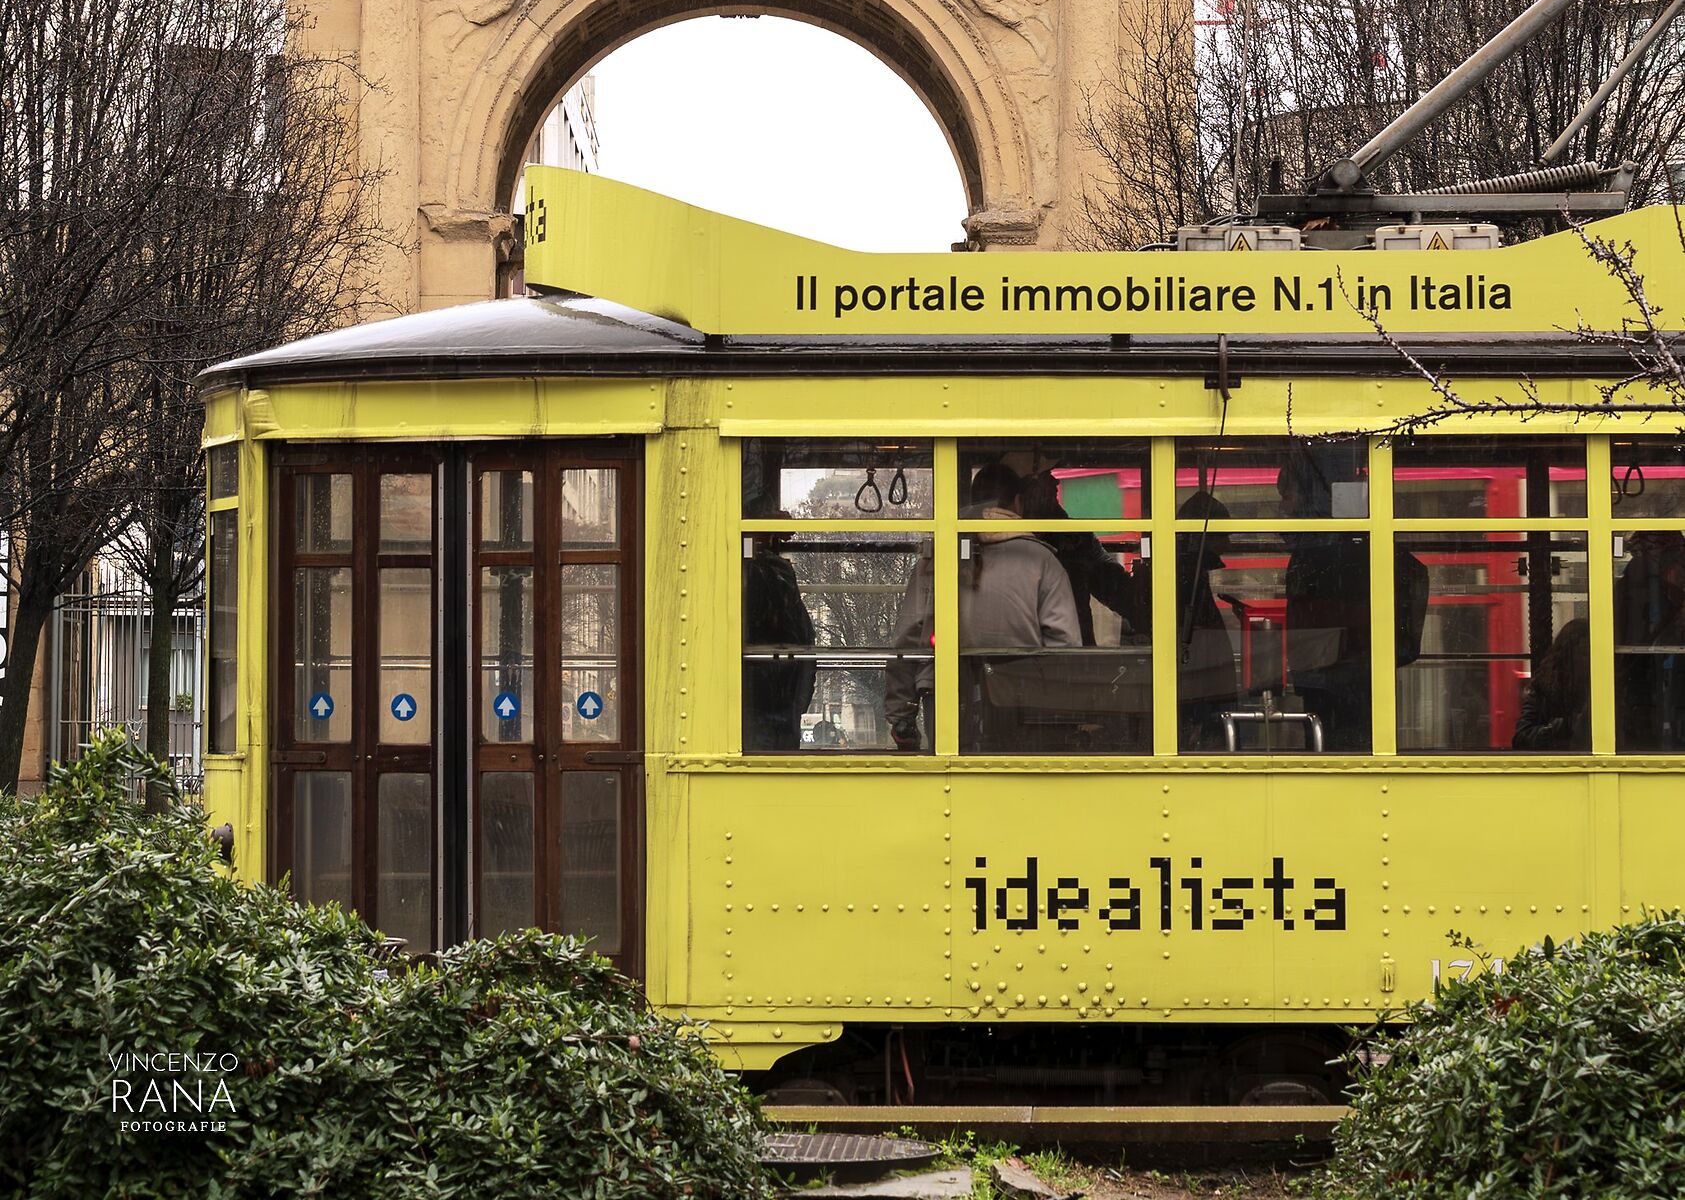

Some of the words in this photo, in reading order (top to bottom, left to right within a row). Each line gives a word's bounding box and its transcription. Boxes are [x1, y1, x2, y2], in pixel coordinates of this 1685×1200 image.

[796, 275, 817, 311] Il
[834, 276, 985, 318] portale
[1002, 276, 1256, 312] immobiliare
[1274, 276, 1333, 311] N.1
[1357, 275, 1392, 311] in
[1410, 275, 1512, 311] Italia
[965, 856, 1346, 931] idealista
